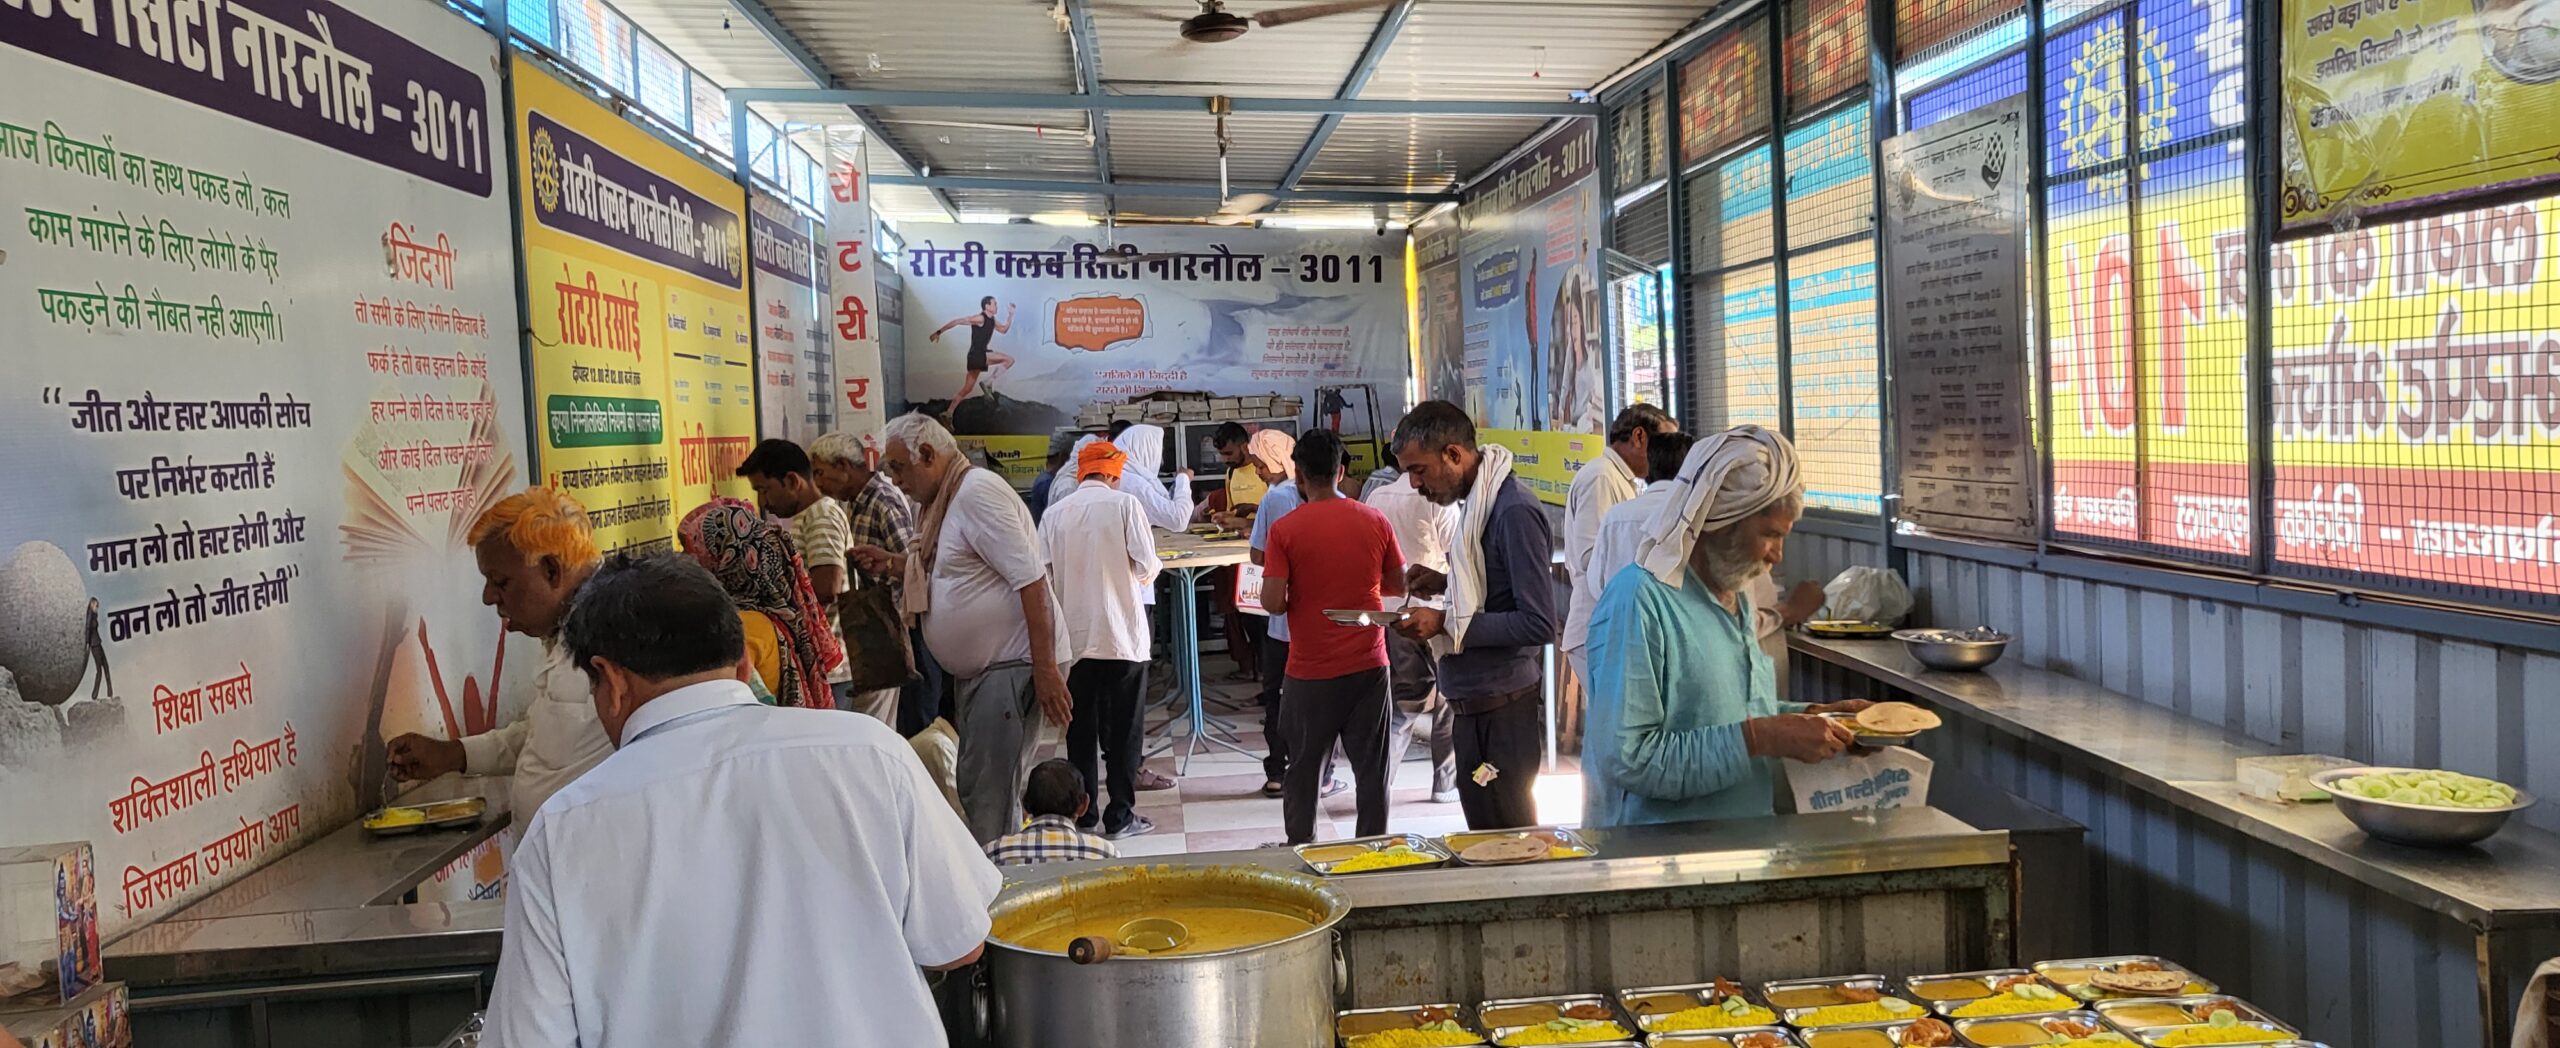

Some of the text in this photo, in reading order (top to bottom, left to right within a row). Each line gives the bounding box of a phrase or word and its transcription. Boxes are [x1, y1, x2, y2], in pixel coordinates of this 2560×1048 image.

[226, 11, 375, 134] नारनौल
[407, 80, 483, 174] 3011
[44, 120, 117, 181] किताबों
[120, 152, 147, 188] का
[150, 160, 185, 196] हाथ
[261, 187, 291, 220] कल
[1561, 130, 1590, 179] 3011
[559, 142, 728, 271] रोटरी क्लब नारनौल सिटी 3011
[25, 207, 73, 248] काम
[78, 205, 132, 256] मांगने
[136, 215, 155, 258] के
[159, 219, 196, 272] लिए
[197, 228, 237, 272] लोगो
[240, 235, 256, 274] के
[909, 240, 1383, 284] रोटरी क्लब सिटी नारनौल 3011
[38, 281, 110, 334] पकड़ने
[113, 284, 141, 330] की
[144, 288, 192, 334] नौबत
[194, 294, 225, 339] नही
[355, 294, 368, 324] तो
[370, 296, 392, 327] सभी
[394, 299, 405, 328] के
[407, 301, 427, 335] लिए
[428, 302, 450, 334] रंगीन
[452, 308, 478, 337] किताब
[555, 262, 601, 347] रोटरी
[603, 279, 641, 363] रसोई
[367, 345, 488, 383] फर्क है तो बस इतना कि कोई
[69, 389, 312, 433] जीत और हार आपकी सोच
[370, 401, 385, 425] हर
[387, 394, 407, 423] पन्ने
[408, 395, 423, 422] को
[424, 394, 443, 422] दिल
[446, 395, 454, 421] से
[116, 469, 150, 500] पर
[152, 455, 208, 497] निर्भर
[208, 451, 260, 492] करती
[378, 441, 398, 472] और
[401, 440, 421, 472] कोई
[422, 440, 442, 468] दिल
[443, 438, 464, 467] रखने
[680, 420, 707, 487] रोटरी
[406, 487, 425, 516] पन्ने
[427, 492, 450, 513] पलट
[87, 508, 306, 573] मान लो तो हार होगी और
[108, 604, 150, 642] ठान
[154, 588, 180, 632] लो
[183, 583, 207, 625] तो
[210, 577, 249, 617] जीत
[152, 661, 253, 735] शिक्षा सबसे
[109, 721, 299, 834] शक्तिशाली हथियार है
[123, 803, 301, 919] जिसका उपयोग आप
